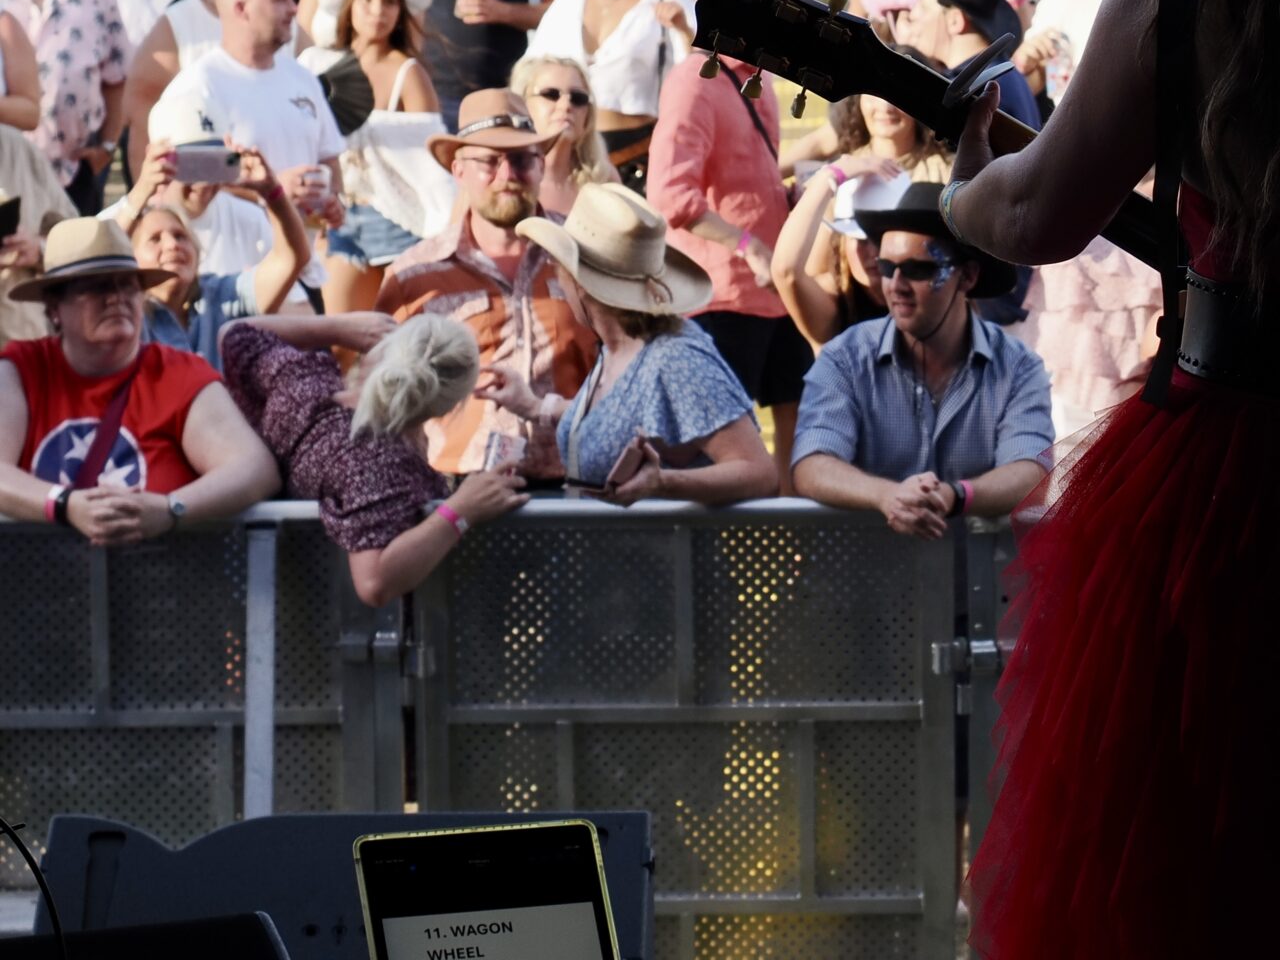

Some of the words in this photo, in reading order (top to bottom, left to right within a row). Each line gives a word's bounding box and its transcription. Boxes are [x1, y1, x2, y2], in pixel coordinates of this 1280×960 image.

[424, 928, 447, 940] 11.
[449, 921, 514, 939] WAGON
[426, 946, 485, 960] WHEEL
